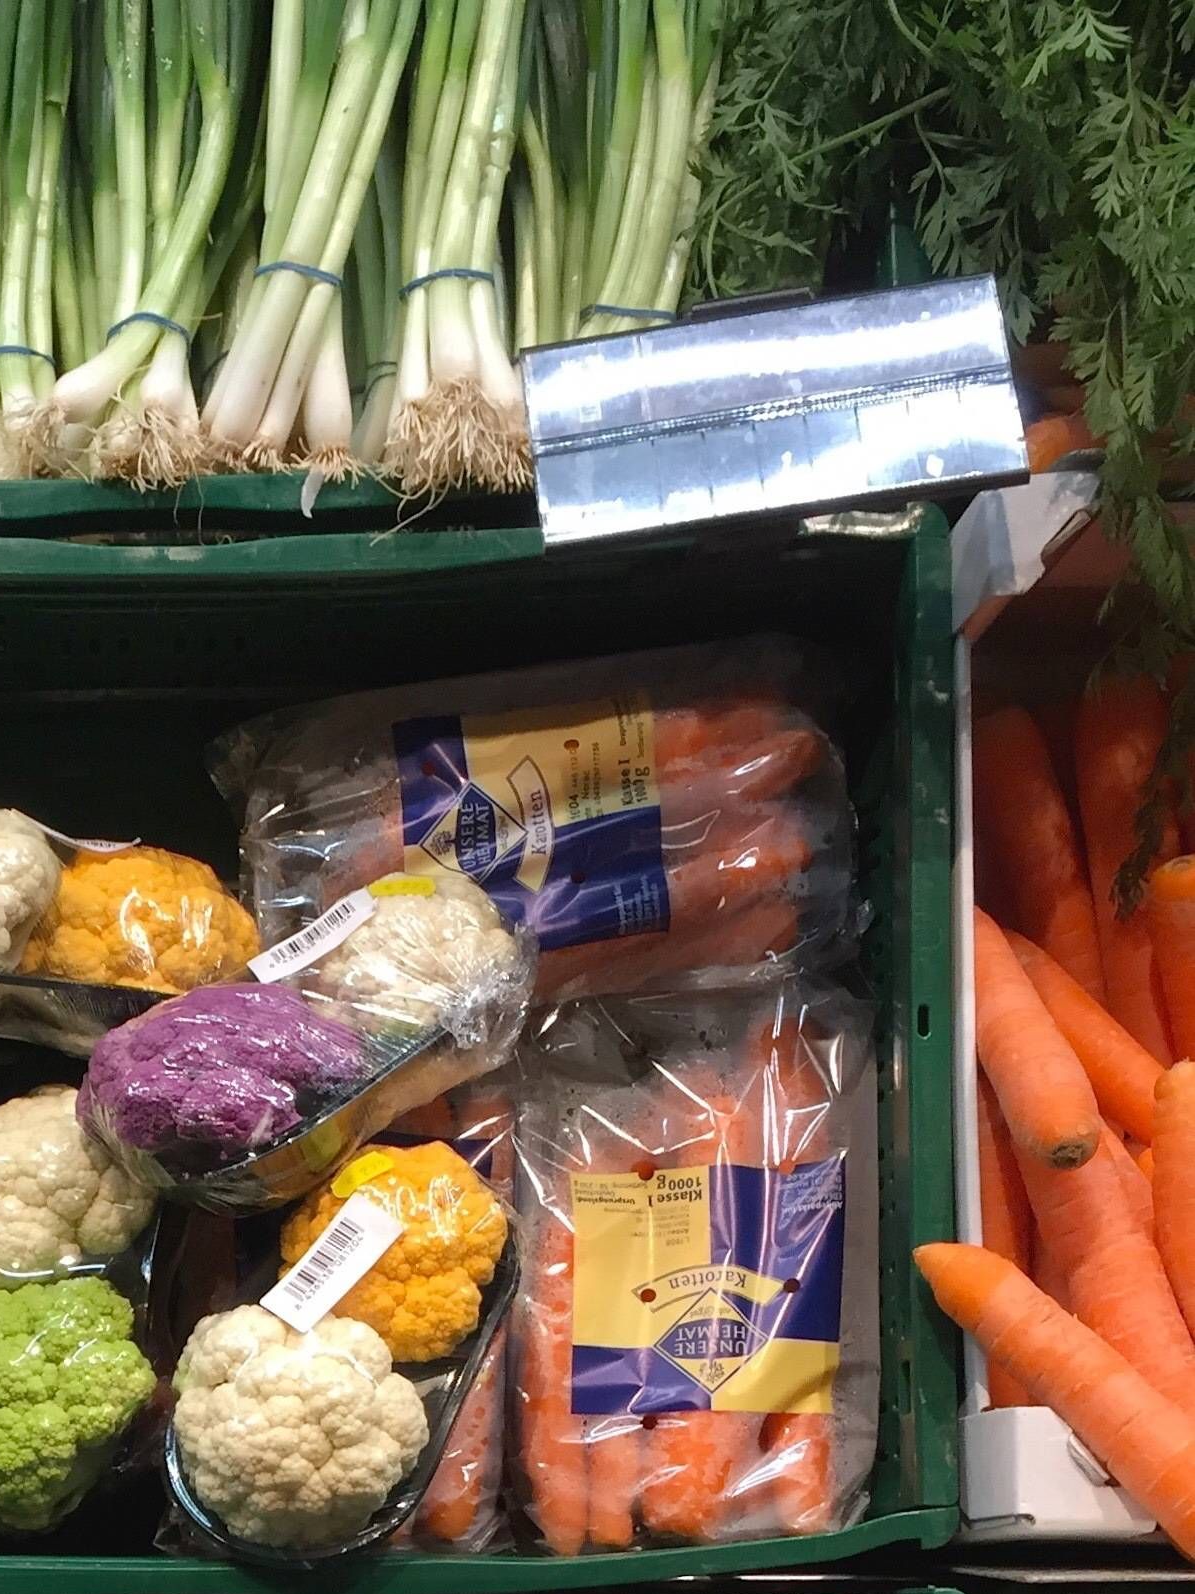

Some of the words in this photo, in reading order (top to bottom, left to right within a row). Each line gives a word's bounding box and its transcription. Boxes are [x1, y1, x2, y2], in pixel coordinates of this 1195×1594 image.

[530, 789, 547, 855] Karotten
[461, 802, 476, 869] UNSERE
[476, 803, 491, 865] HEIMAT
[657, 1190, 702, 1203] Klasse
[669, 1268, 747, 1289] Karotten
[676, 1323, 747, 1341] HEIMAT
[675, 1339, 748, 1356] UNSERE
